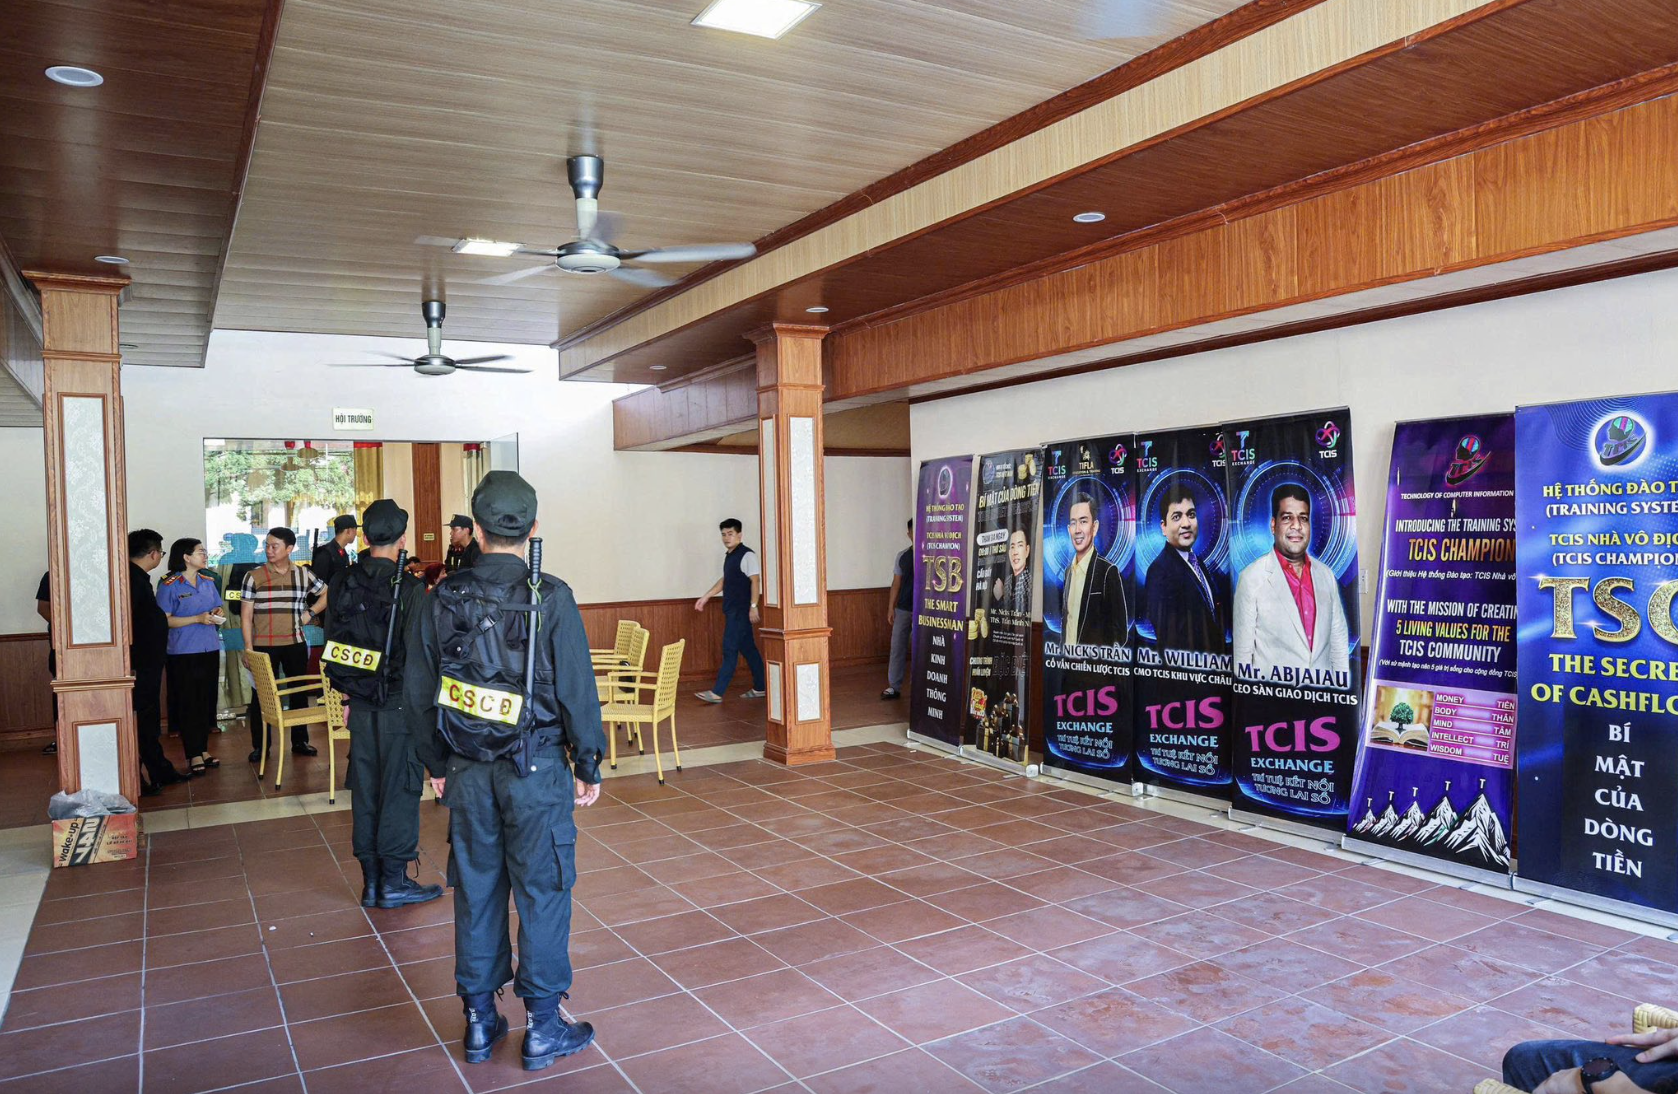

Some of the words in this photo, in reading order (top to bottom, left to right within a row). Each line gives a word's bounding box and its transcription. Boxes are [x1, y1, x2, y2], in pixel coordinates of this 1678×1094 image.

[335, 413, 346, 424] HỘI
[348, 413, 372, 423] TRƯỜNG
[1136, 457, 1158, 468] TCIS
[1231, 448, 1255, 461] TCIS
[1319, 450, 1338, 459] TCIS
[1048, 466, 1066, 476] TCIS
[1111, 467, 1125, 475] TCIS
[1543, 482, 1563, 499] HỆ
[1626, 479, 1665, 495] ĐÀO
[1546, 502, 1627, 518] (TRAINING
[1395, 519, 1445, 532] INTRODUCING
[1447, 518, 1461, 532] THE
[1463, 518, 1501, 532] TRAINING
[1549, 534, 1583, 545] TCIS
[1587, 531, 1621, 546] NHÀ
[1624, 530, 1649, 545] VÔ
[1408, 538, 1437, 561] TCIS
[1440, 538, 1516, 562] CHAMPION
[1552, 553, 1592, 566] (TCIS
[1595, 552, 1678, 566] CHAMPIO
[923, 556, 963, 592] TSB
[1474, 571, 1491, 579] TCIS
[924, 598, 935, 610] THE
[936, 600, 958, 612] SMART
[1387, 599, 1407, 614] WITH
[1409, 600, 1426, 615] THE
[1427, 601, 1464, 617] MISSION
[1466, 602, 1480, 618] OF
[918, 614, 964, 631] BUSINESSMAN
[1396, 620, 1402, 635] 5
[1403, 620, 1433, 637] LIVING
[1435, 622, 1468, 639] VALUES
[1471, 624, 1489, 641] FOR
[1492, 625, 1511, 642] THE
[932, 635, 946, 647] NHÀ
[331, 646, 374, 666] CSCĐ
[931, 653, 946, 665] KINH
[1046, 642, 1061, 655] Mr.
[1064, 644, 1098, 658] NICK'S
[1100, 642, 1130, 661] TRẦN
[1139, 648, 1162, 664] Mr.
[1165, 651, 1232, 671] WILLIAM
[1400, 640, 1425, 657] TCIS
[1427, 641, 1501, 663] COMMUNITY
[1057, 658, 1070, 670] VẤN
[1071, 660, 1092, 672] CHIẾN
[1093, 664, 1113, 676] LƯỢC
[1113, 667, 1130, 676] TCIS
[1238, 663, 1265, 680] Mr.
[1270, 666, 1348, 688] ABJAIAU
[1549, 653, 1596, 675] THE
[1601, 657, 1678, 682] SECRE
[927, 670, 948, 684] DOANH
[1134, 667, 1151, 677] CMO
[1153, 669, 1170, 679] TCIS
[1171, 672, 1188, 681] KHU
[1189, 673, 1207, 684] VỰC
[1208, 674, 1232, 686] CHÂU
[449, 684, 512, 715] CSCĐ
[926, 688, 947, 702] THÔNG
[1054, 685, 1118, 717] TCIS
[1233, 683, 1250, 694] CEO
[1252, 684, 1273, 696] SÀN
[1275, 687, 1302, 699] GIAO
[1304, 691, 1331, 703] DỊCH
[1332, 694, 1359, 705] TCIS
[1436, 694, 1464, 704] MONEY
[1531, 683, 1564, 703] OF
[928, 706, 943, 720] MINH
[1145, 696, 1224, 729] TCIS
[1435, 707, 1457, 716] BODY
[1492, 713, 1514, 723] THÂN
[1057, 722, 1113, 733] EXCHANGE
[1245, 716, 1341, 752] TCIS
[1433, 719, 1453, 728] MIND
[1494, 726, 1512, 736] TÂM
[1608, 722, 1631, 743] BÍ
[1150, 734, 1219, 747] EXCHANGE
[1431, 731, 1474, 744] INTELLECT
[1496, 740, 1509, 749] TRÍ
[1430, 744, 1462, 755] WISDOM
[1493, 753, 1509, 763] TUỆ
[1181, 762, 1197, 773] LAI
[1251, 758, 1335, 773] EXCHANGE
[1594, 754, 1645, 780] MẬT
[1285, 775, 1305, 788] KẾT
[1307, 778, 1334, 792] NỐI
[1412, 787, 1418, 797] T
[1445, 780, 1451, 791] T
[1479, 778, 1486, 789] T
[1289, 789, 1309, 801] LAI
[1310, 791, 1331, 805] SỐ
[1367, 798, 1373, 807] T
[1388, 791, 1394, 801] T
[1594, 785, 1644, 811] CỦA
[1584, 817, 1653, 846] DÒNG
[59, 821, 80, 862] wake-up
[1592, 849, 1642, 878] TIỀN
